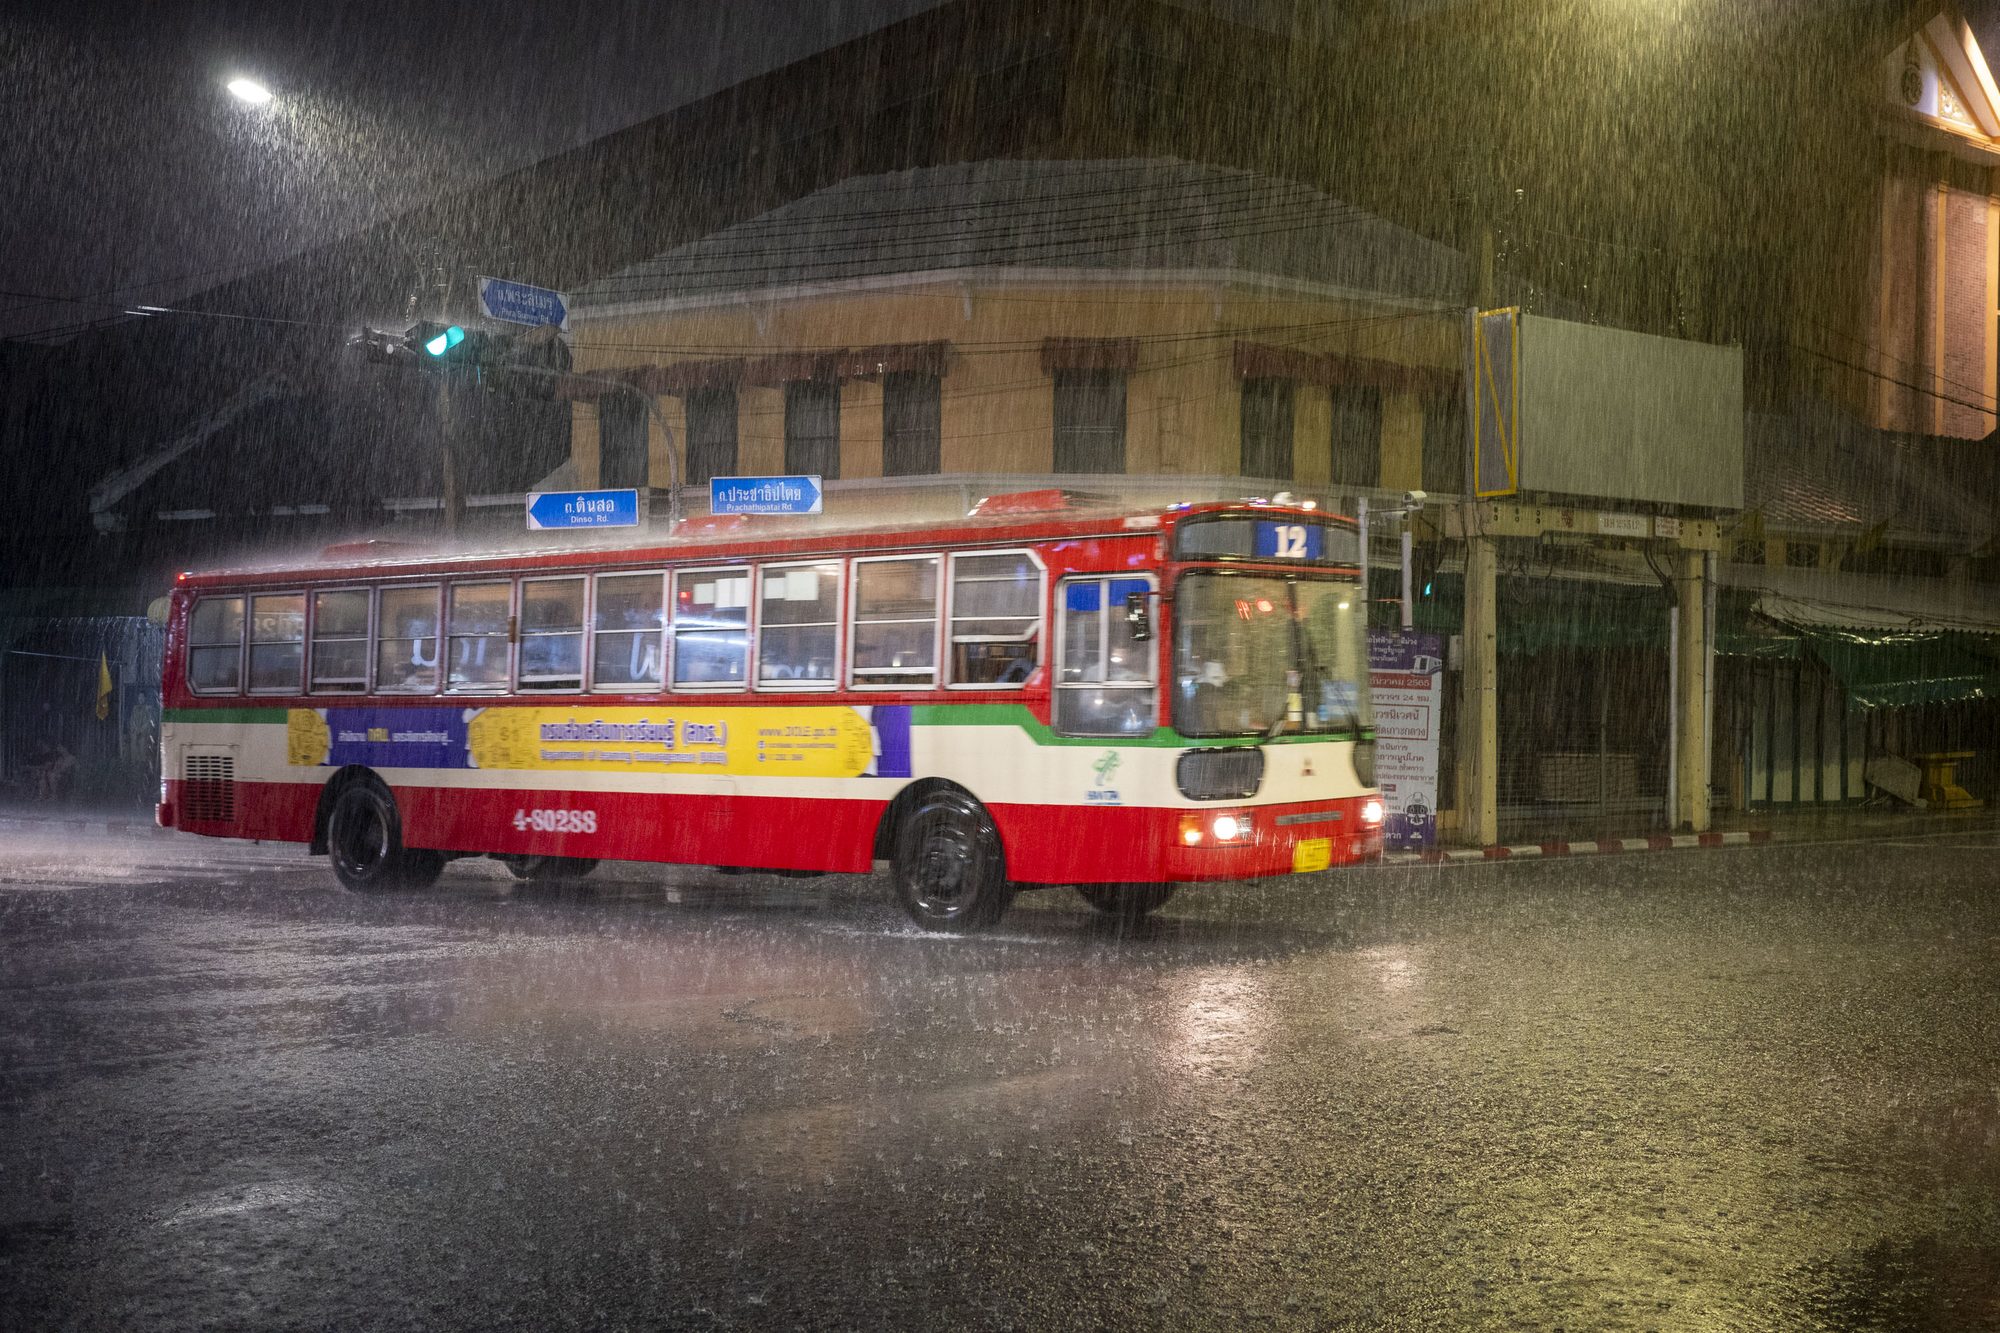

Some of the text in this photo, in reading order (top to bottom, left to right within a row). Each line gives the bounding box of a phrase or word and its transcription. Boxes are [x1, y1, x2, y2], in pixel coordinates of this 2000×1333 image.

[719, 482, 801, 502] ถ.ประชาธิปไตย
[565, 496, 615, 514] ถ.ดินสอ
[726, 503, 780, 512] Prachathipatai
[571, 515, 609, 524] Dinso Rd.
[1274, 525, 1308, 558] 12
[1407, 679, 1430, 687] 2565
[1375, 725, 1426, 736] ชิดเกาะกลาง
[512, 808, 598, 834] 4-80288
